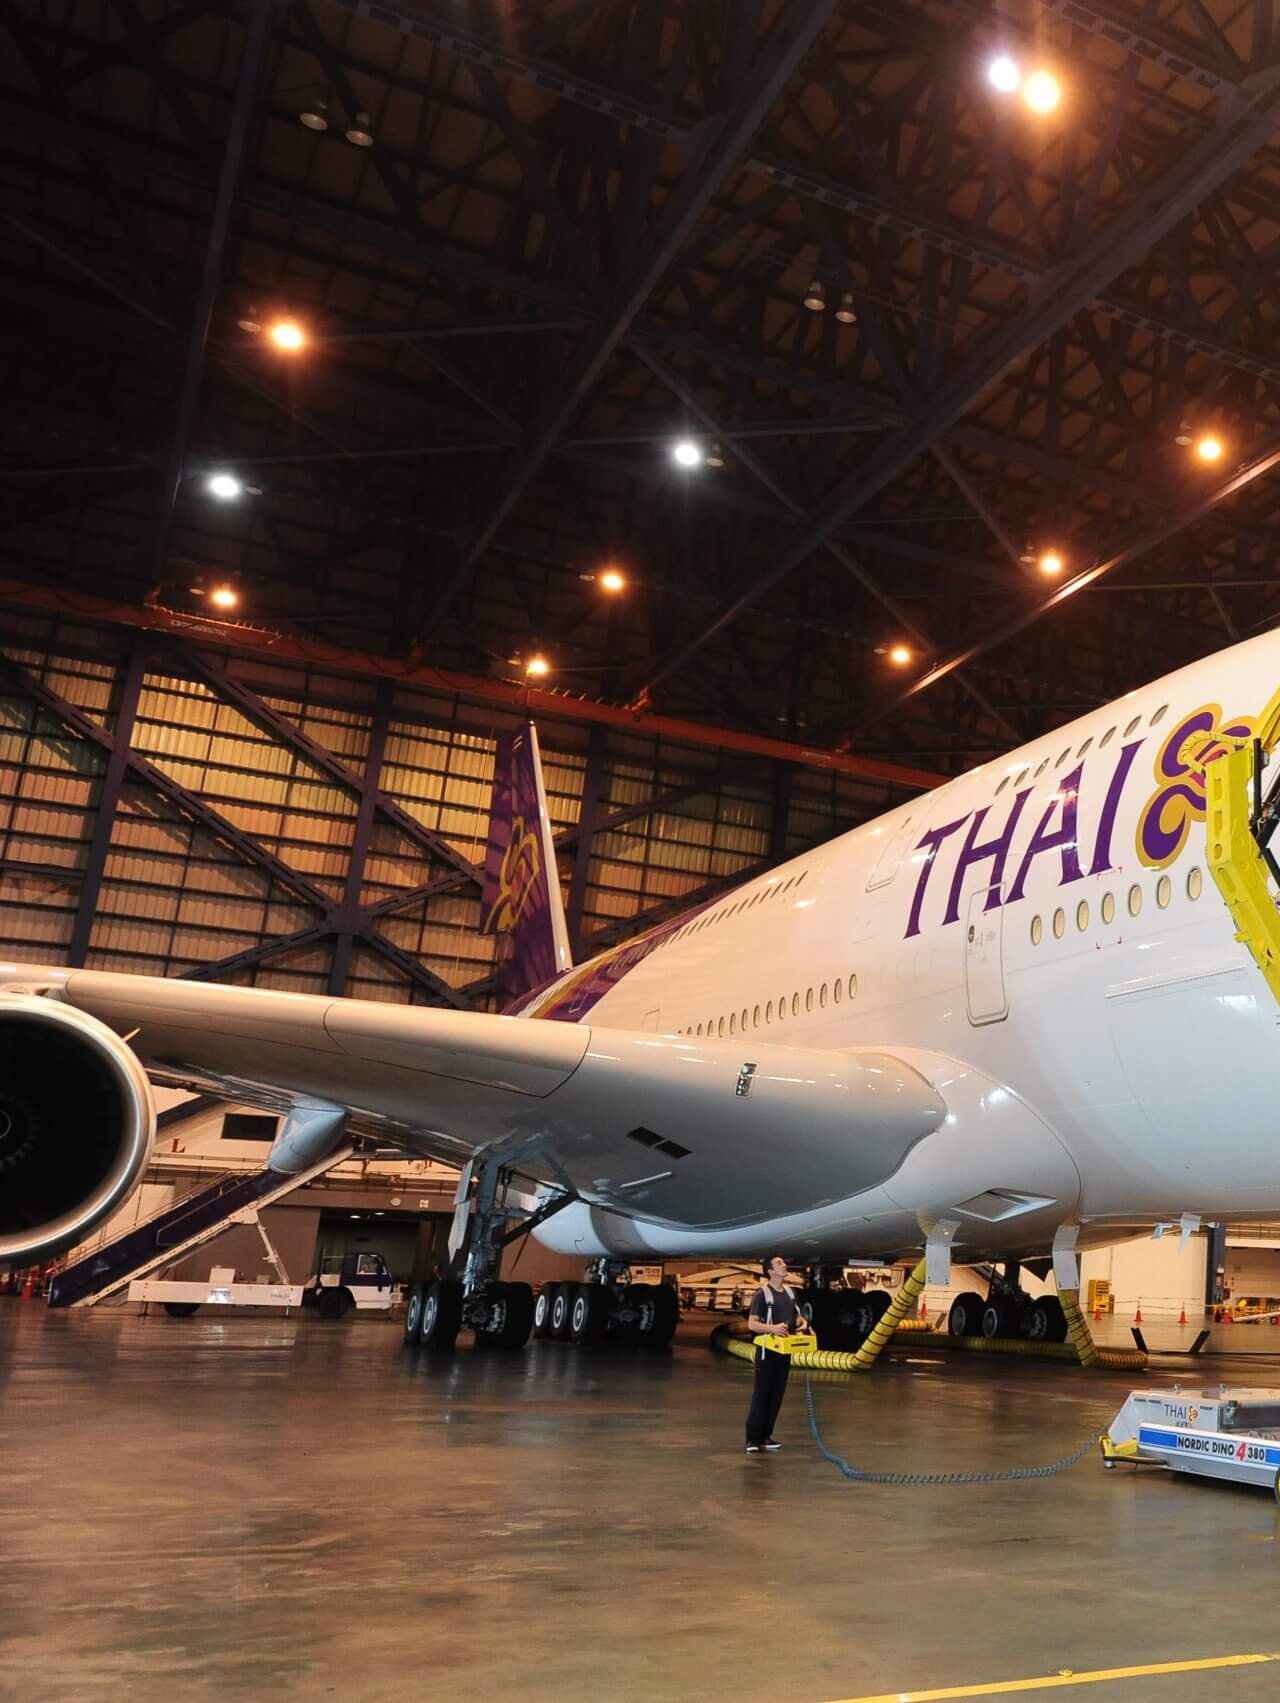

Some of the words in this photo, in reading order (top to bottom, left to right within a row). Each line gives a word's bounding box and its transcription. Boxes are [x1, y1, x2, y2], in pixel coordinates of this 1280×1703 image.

[903, 738, 1147, 939] THAI
[1164, 1403, 1187, 1420] THAI
[1177, 1436, 1210, 1453] NORDIC
[1211, 1442, 1235, 1456] DINO
[1235, 1441, 1249, 1462] 4
[1247, 1446, 1266, 1461] 380
